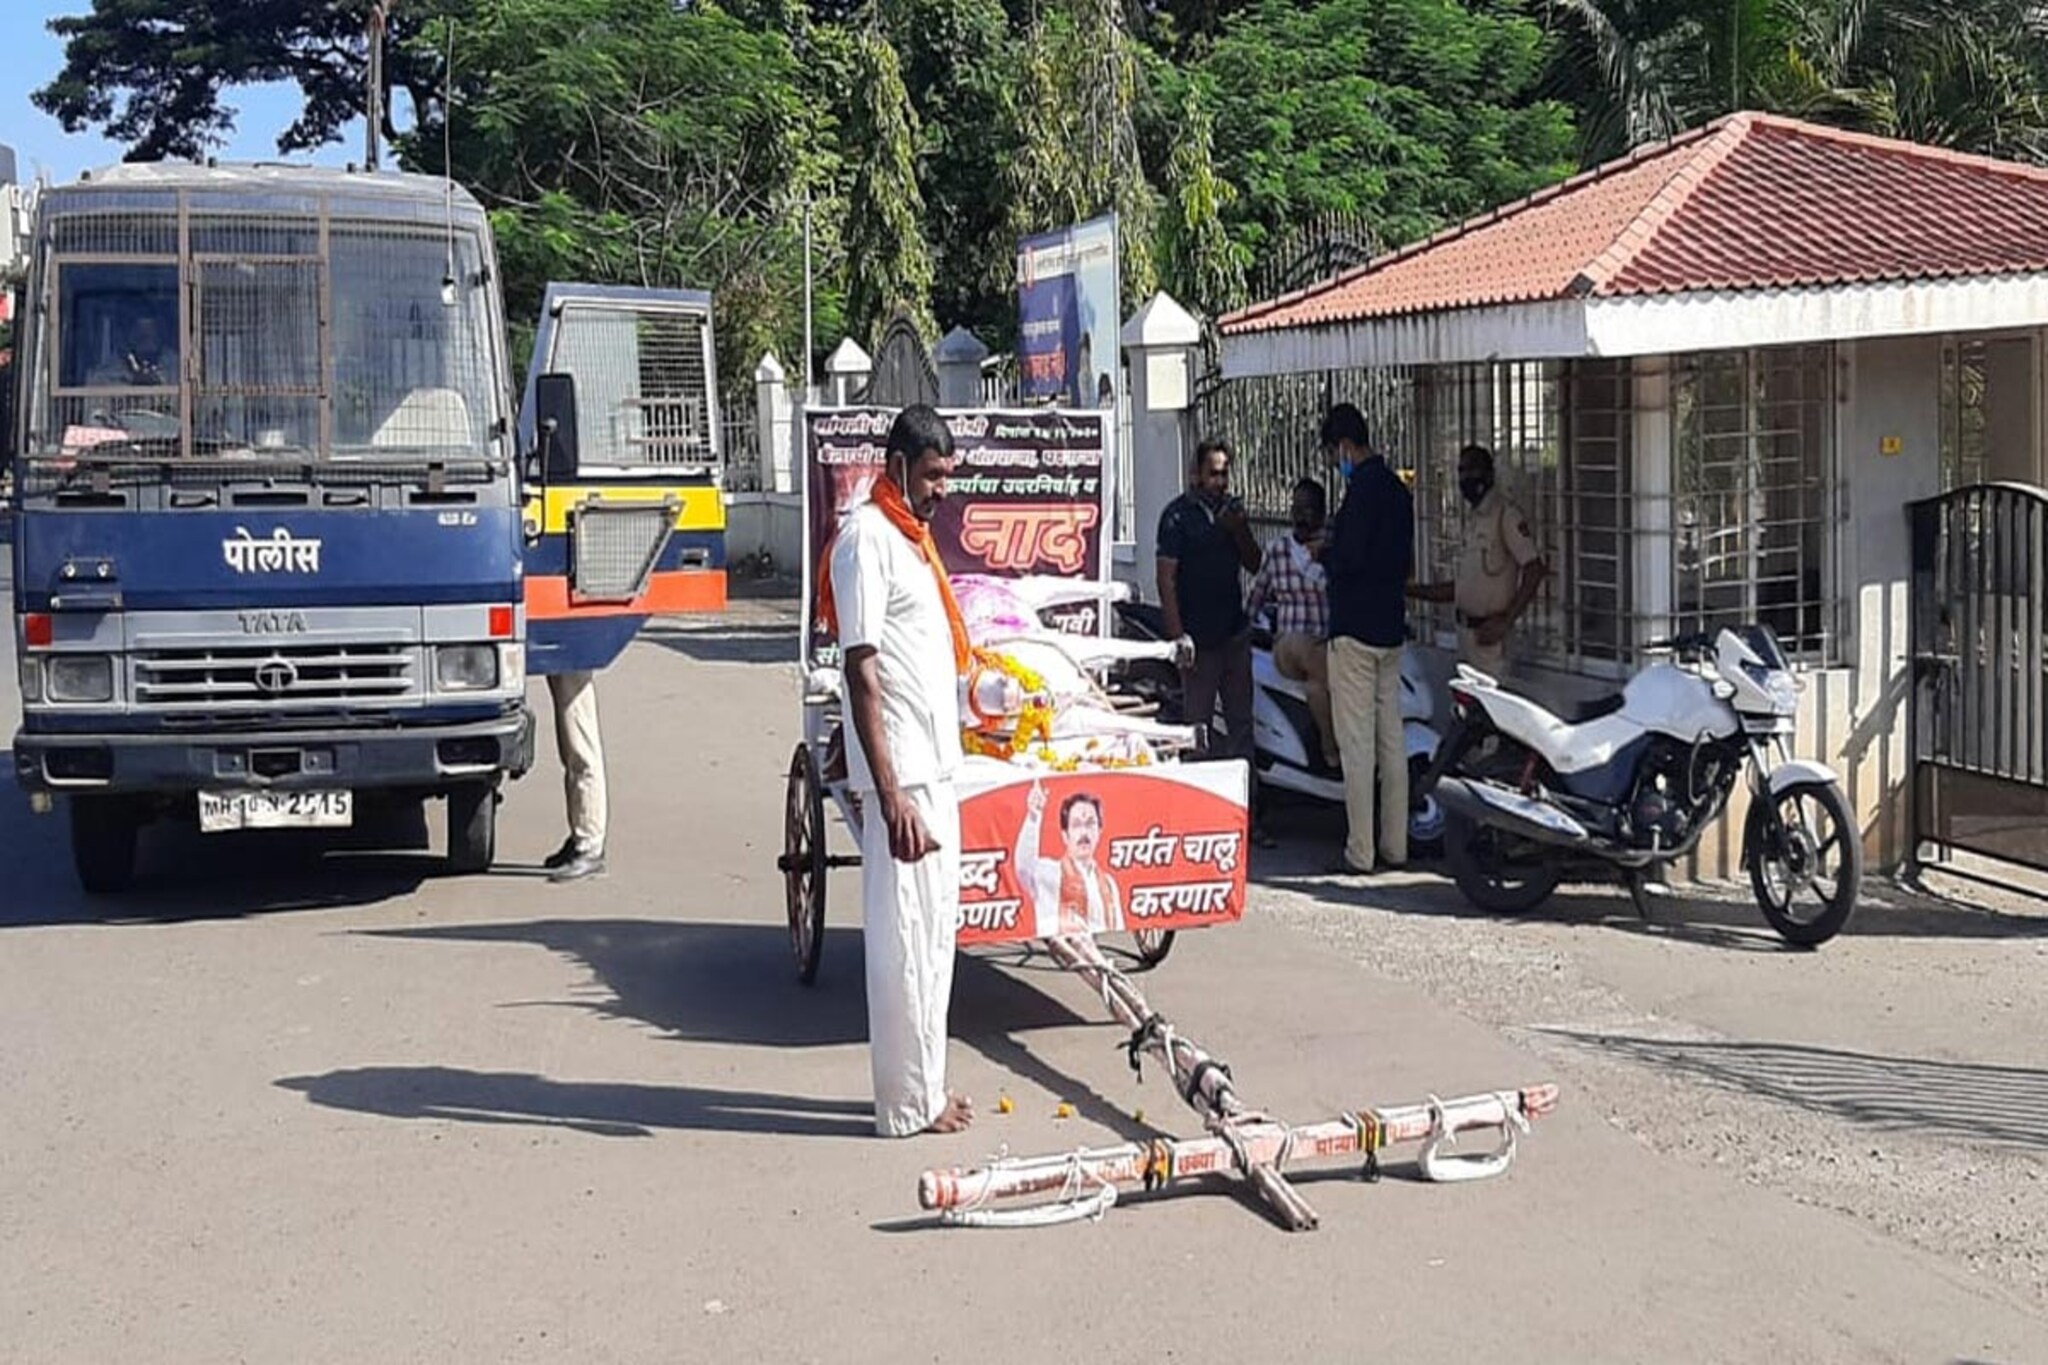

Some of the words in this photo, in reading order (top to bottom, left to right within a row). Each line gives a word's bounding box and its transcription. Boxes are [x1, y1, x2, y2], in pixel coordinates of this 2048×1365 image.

[222, 527, 321, 574] पोलीस
[960, 503, 1098, 573] नाद
[237, 612, 307, 634] TATA
[1108, 827, 1177, 869] शर्यत
[1182, 832, 1242, 873] चालू
[959, 851, 1005, 895] ब्द
[1129, 880, 1234, 918] करणार
